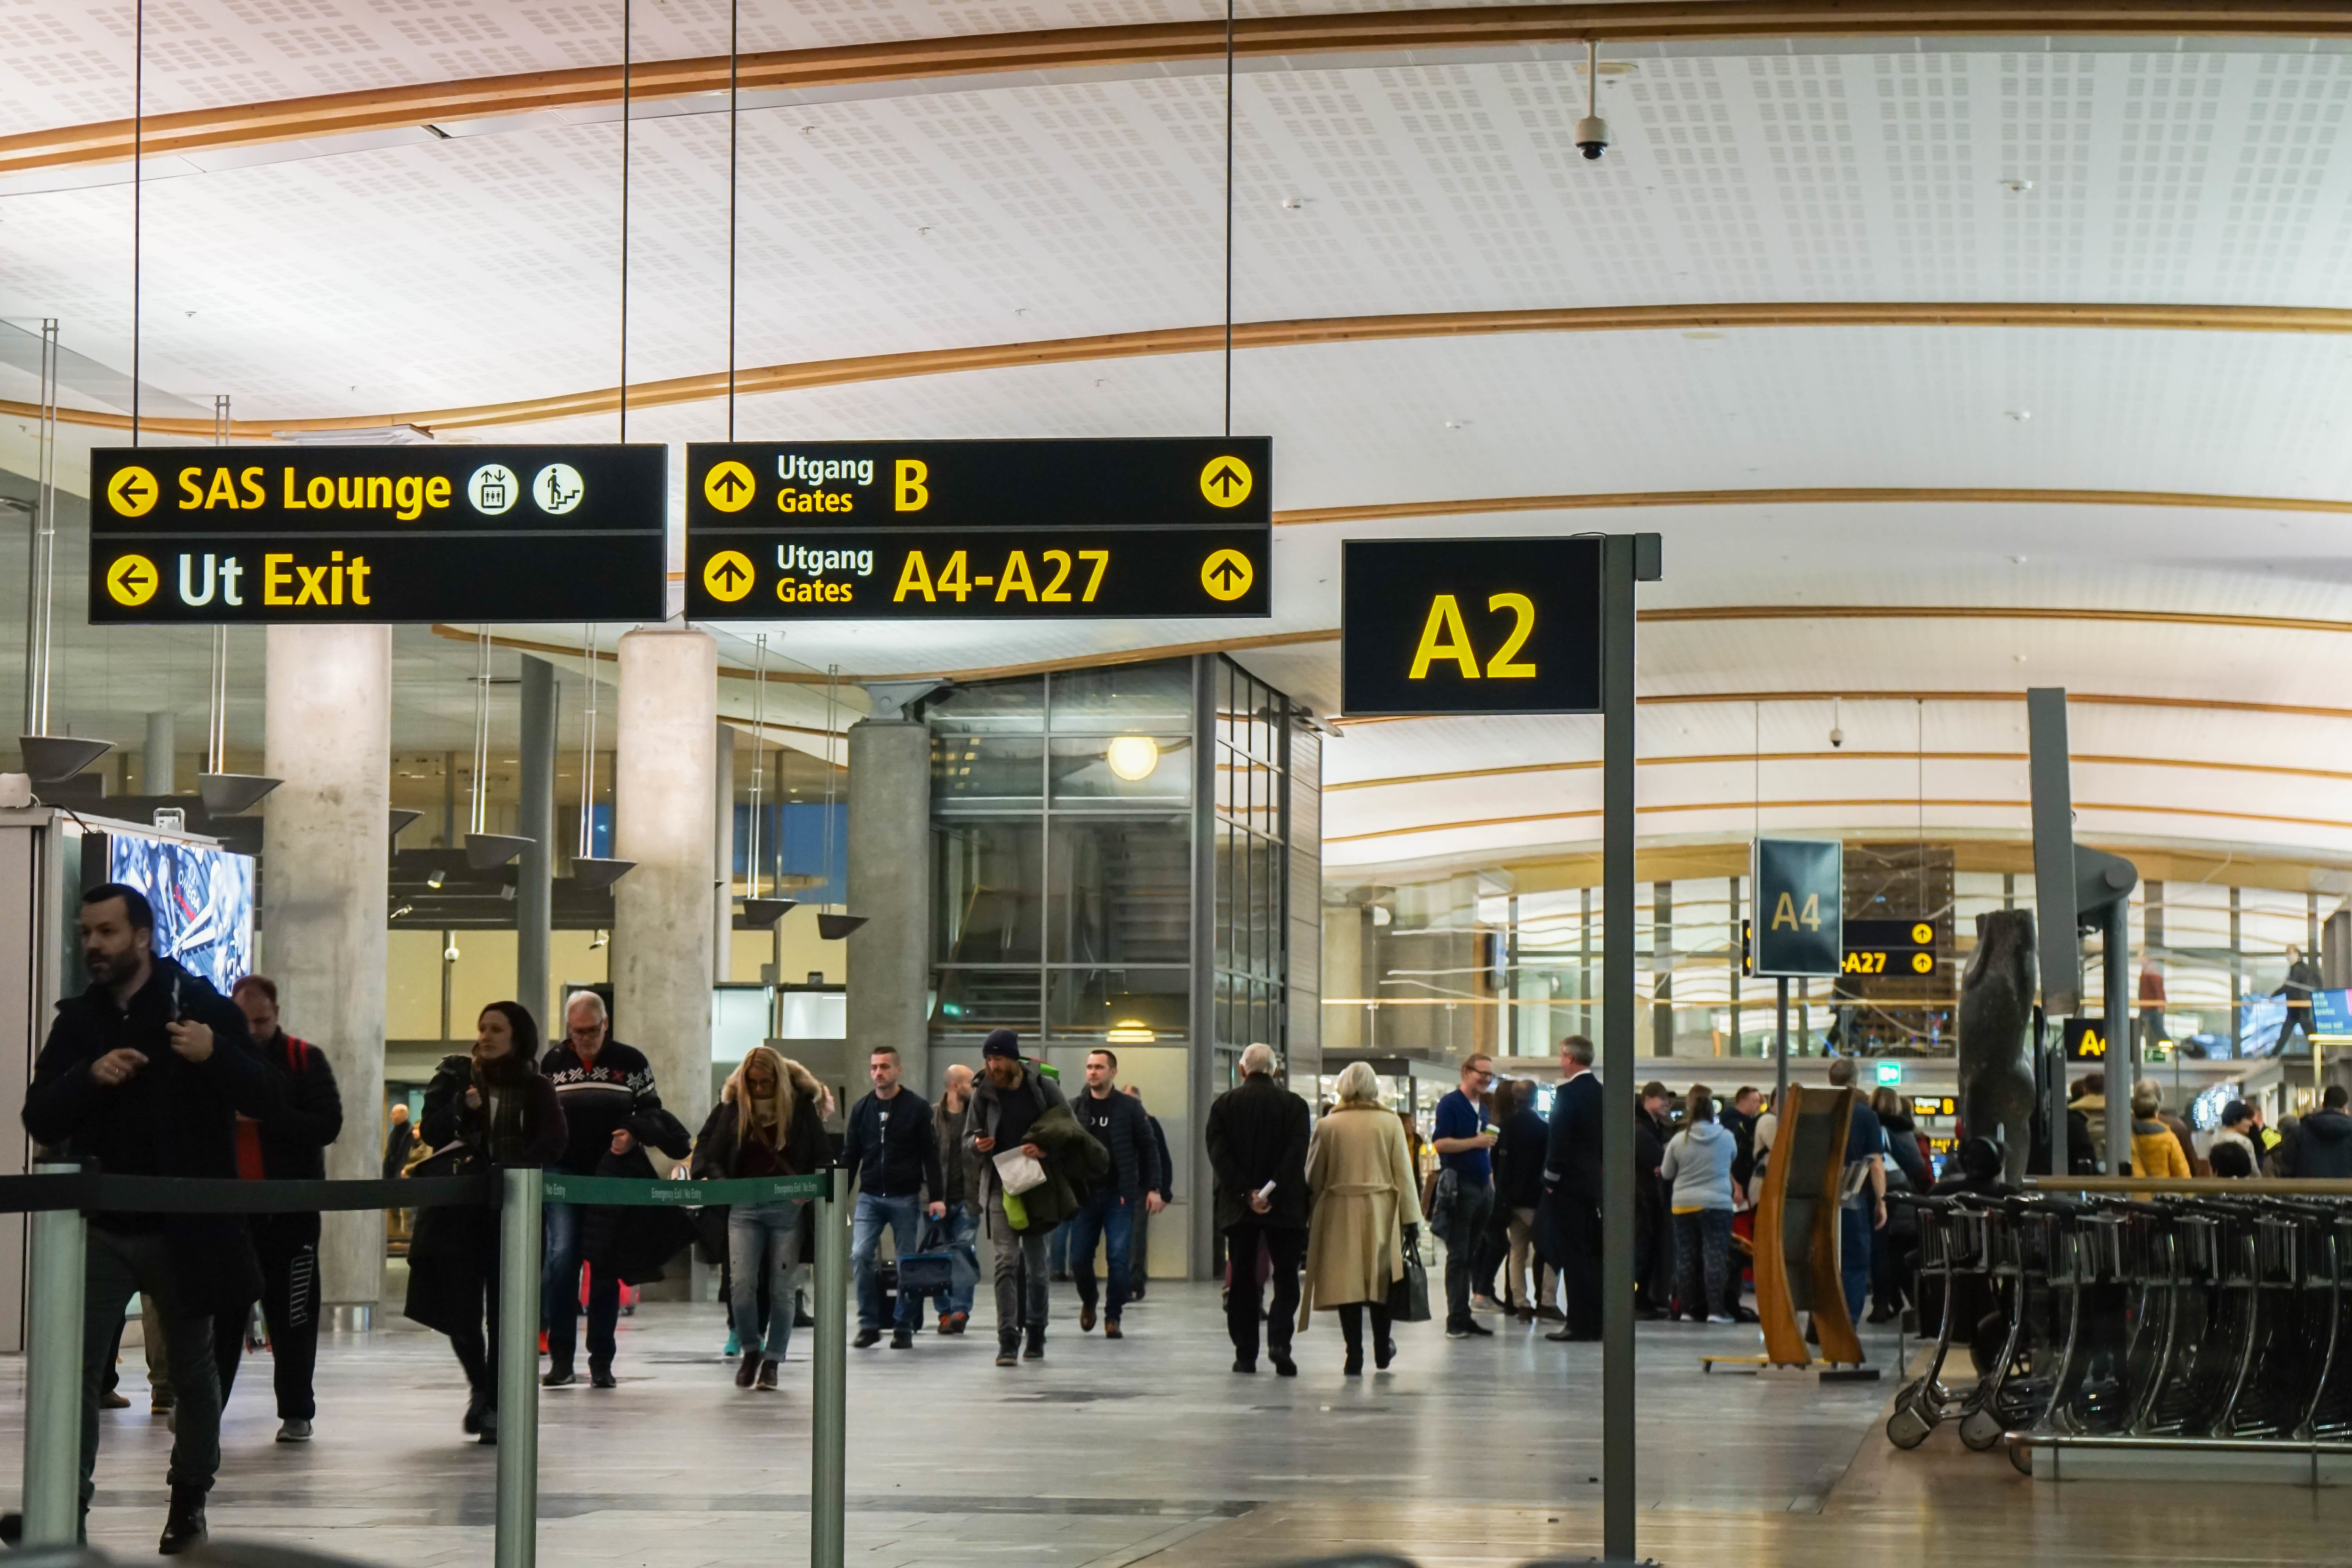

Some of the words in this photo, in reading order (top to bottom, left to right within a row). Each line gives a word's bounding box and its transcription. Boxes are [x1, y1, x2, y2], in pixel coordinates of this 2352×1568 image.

[778, 455, 873, 485] Utgang
[895, 459, 929, 511] B
[179, 467, 265, 509] SAS
[284, 467, 452, 520] Lounge
[777, 488, 853, 513] Gates
[179, 554, 243, 606] Ut
[264, 551, 371, 605] Exit
[777, 545, 873, 576] Utgang
[893, 550, 1109, 602] A4-A27
[777, 577, 853, 603] Gates
[1409, 593, 1535, 678] A2
[178, 869, 200, 914] OMEGA
[1771, 891, 1822, 932] A4
[546, 1183, 553, 1195] No
[554, 1183, 566, 1200] Entry
[652, 1187, 674, 1202] Emergency
[685, 1188, 691, 1199] No
[691, 1188, 702, 1202] Entry
